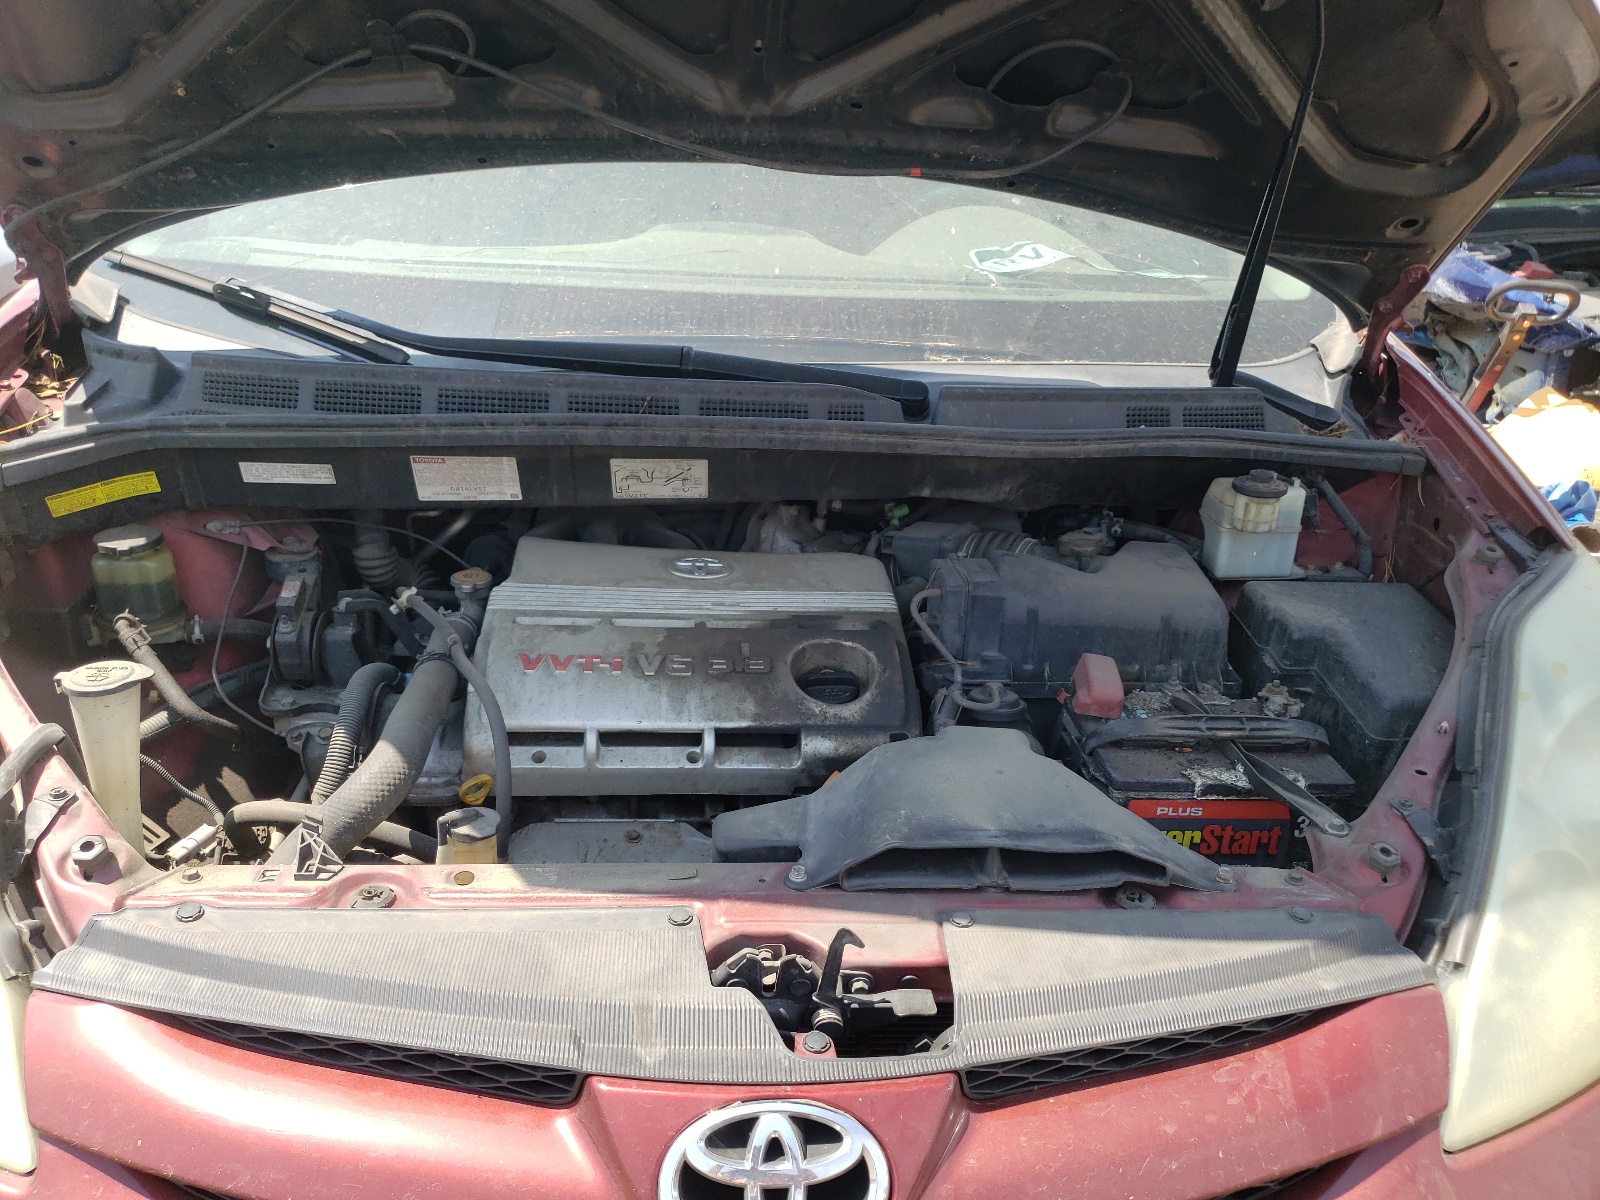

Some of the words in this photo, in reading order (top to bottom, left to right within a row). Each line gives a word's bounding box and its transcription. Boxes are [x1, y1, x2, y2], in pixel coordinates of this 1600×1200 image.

[635, 654, 693, 677] V6
[1156, 807, 1203, 816] PLUS
[1160, 823, 1283, 856] erStart
